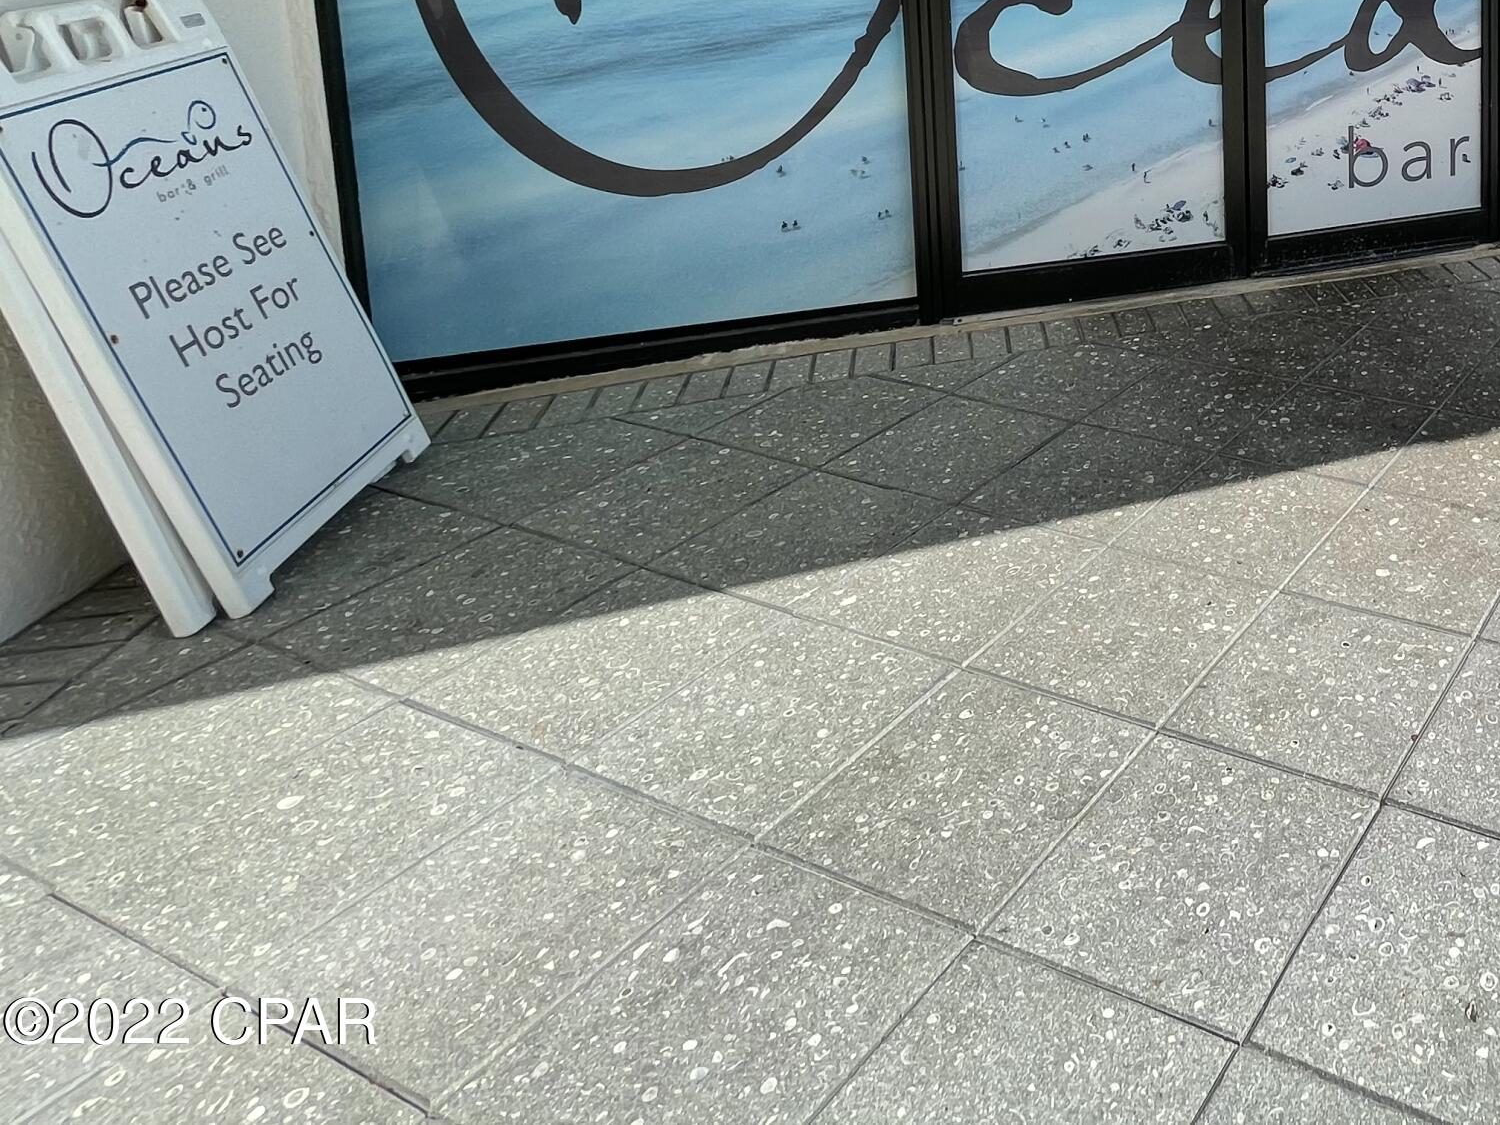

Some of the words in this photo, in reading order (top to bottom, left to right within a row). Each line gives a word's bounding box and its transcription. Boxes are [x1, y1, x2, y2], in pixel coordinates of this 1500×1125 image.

[31, 118, 252, 218] Oceans
[156, 186, 181, 203] bar
[184, 178, 197, 195] &
[203, 165, 229, 186] grill
[1348, 125, 1470, 189] bar
[128, 255, 233, 319] Please
[232, 227, 287, 265] See
[169, 307, 253, 368] Host
[250, 277, 299, 320] For
[215, 331, 322, 408] Seating
